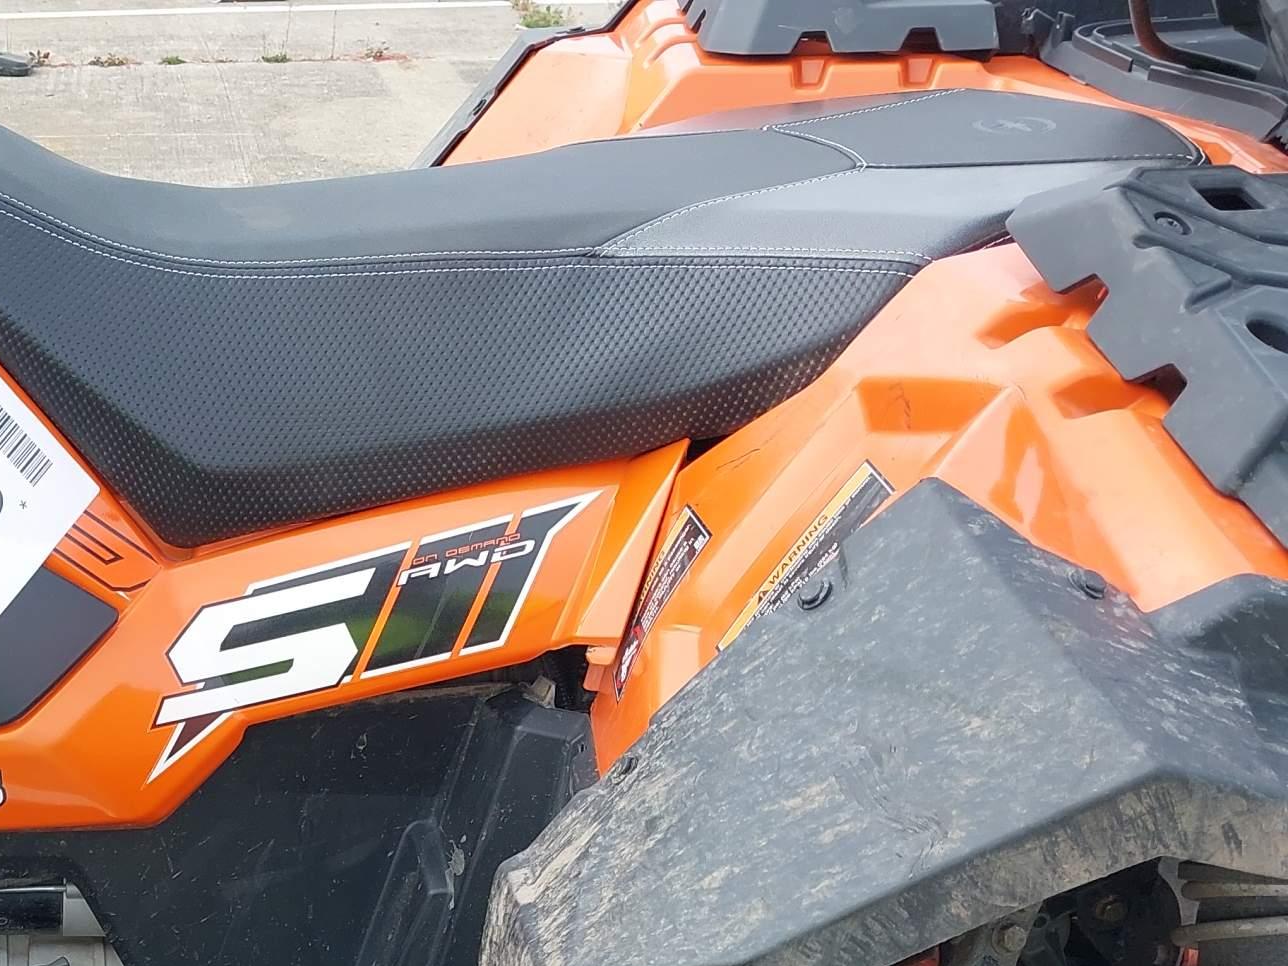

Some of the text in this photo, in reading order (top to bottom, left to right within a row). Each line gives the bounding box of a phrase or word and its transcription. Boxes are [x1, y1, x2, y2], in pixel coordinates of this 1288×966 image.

[394, 538, 538, 586] AWD
[411, 532, 522, 566] ON DEMAND
[765, 513, 832, 586] WARNING
